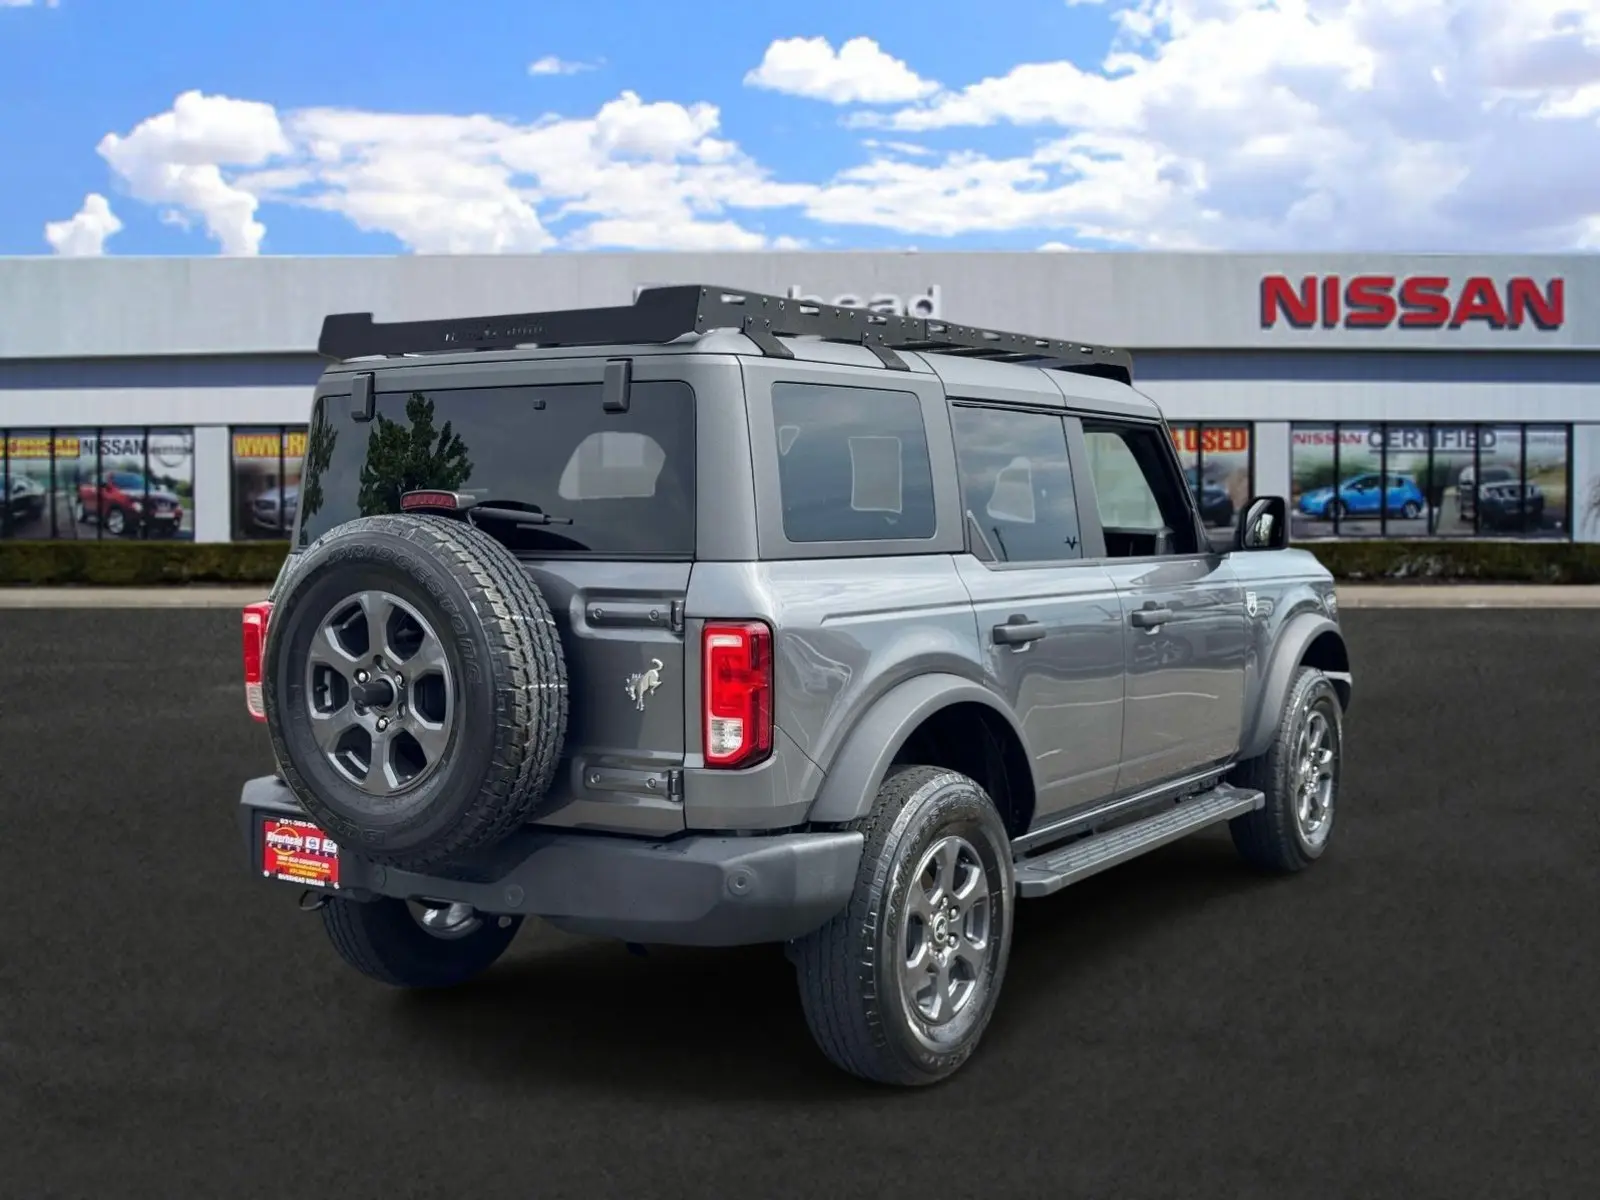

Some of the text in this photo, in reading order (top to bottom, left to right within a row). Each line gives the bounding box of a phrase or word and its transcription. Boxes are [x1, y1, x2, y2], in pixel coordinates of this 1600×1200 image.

[1261, 275, 1564, 330] NISSAN
[81, 438, 146, 455] NSSAN
[1185, 427, 1248, 452] USED
